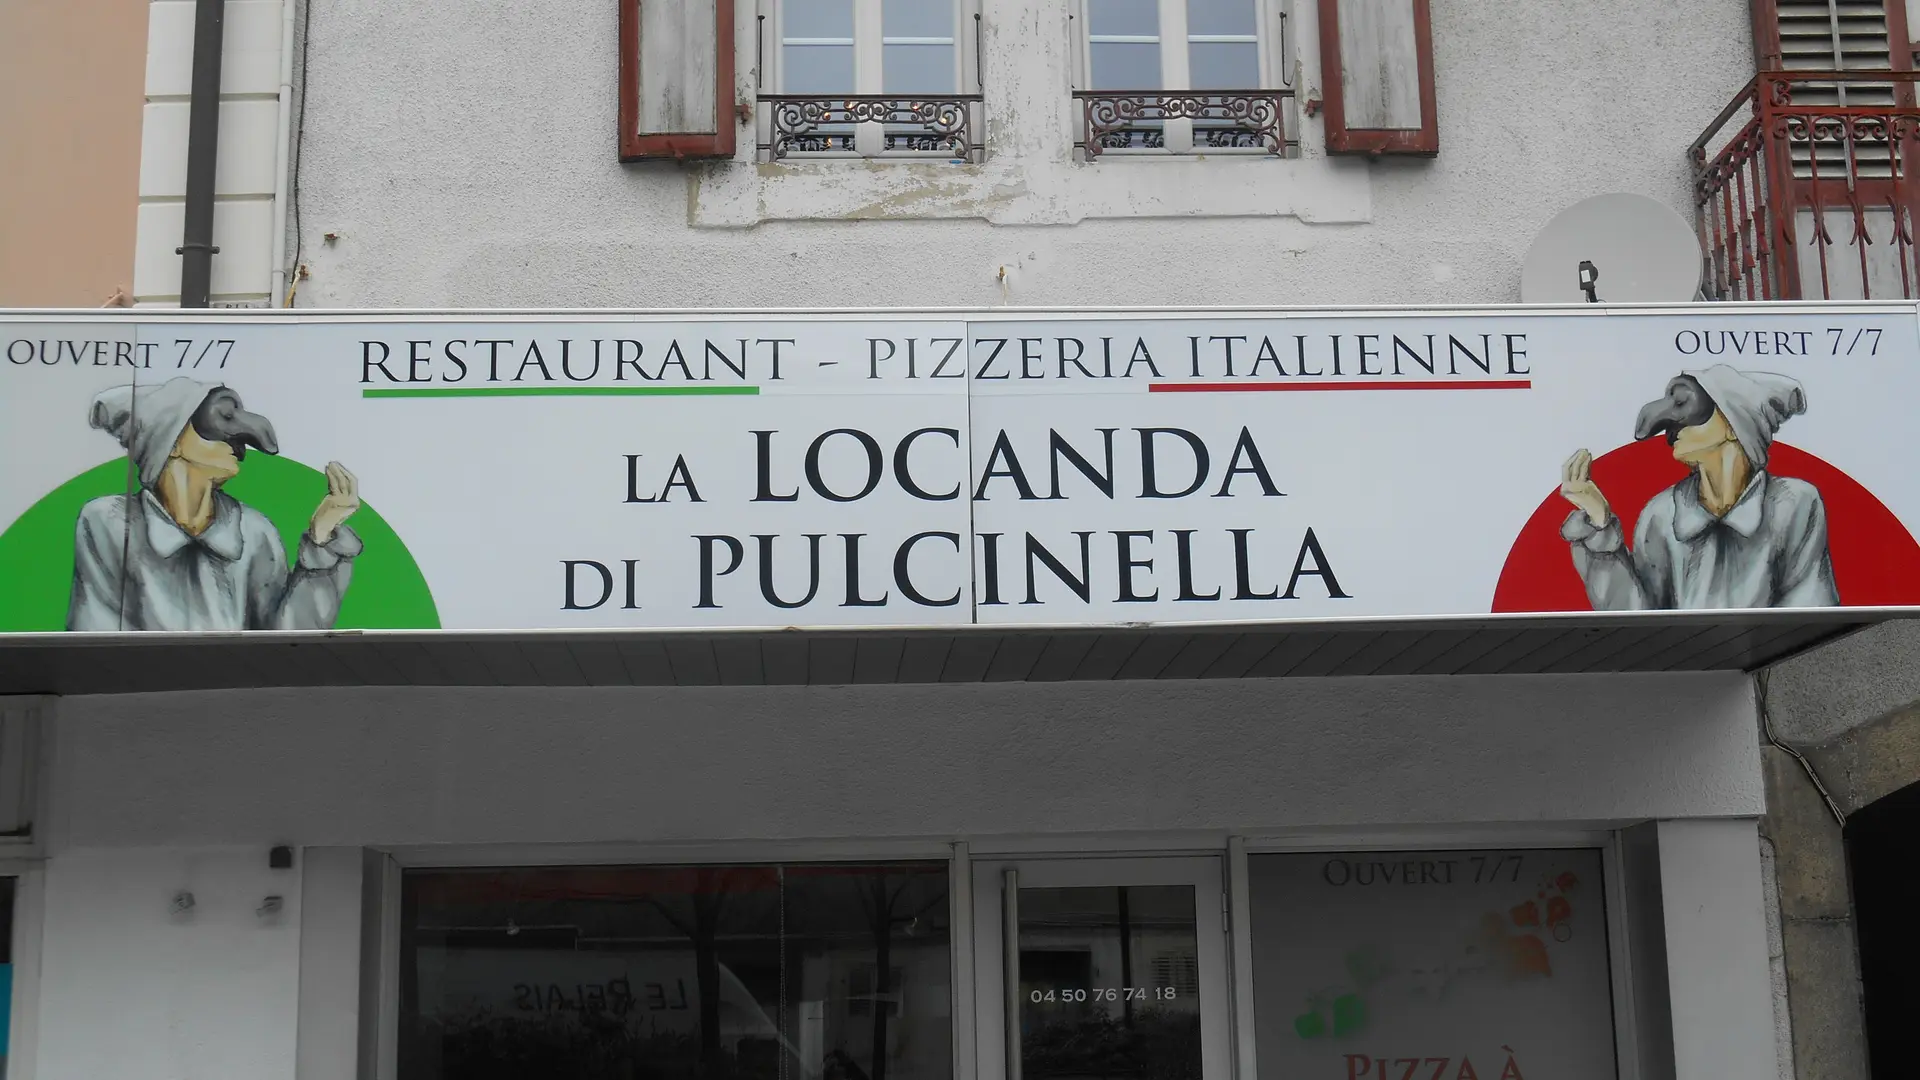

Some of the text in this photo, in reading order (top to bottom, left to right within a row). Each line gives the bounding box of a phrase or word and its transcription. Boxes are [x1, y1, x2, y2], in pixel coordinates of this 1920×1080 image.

[7, 339, 236, 369] OUVERT 7/7
[359, 338, 796, 382] RESTAURANT
[866, 337, 1165, 380] PIZZERIA
[1187, 333, 1531, 378] ITALIENNE
[1675, 327, 1883, 357] OUVERT 7/7
[622, 425, 1288, 503] LA LOCANDA
[559, 526, 1354, 611] DI PULCINELLA
[1323, 856, 1525, 887] OUVERT 7/7
[1030, 986, 1176, 1003] 04 50 76 74 18
